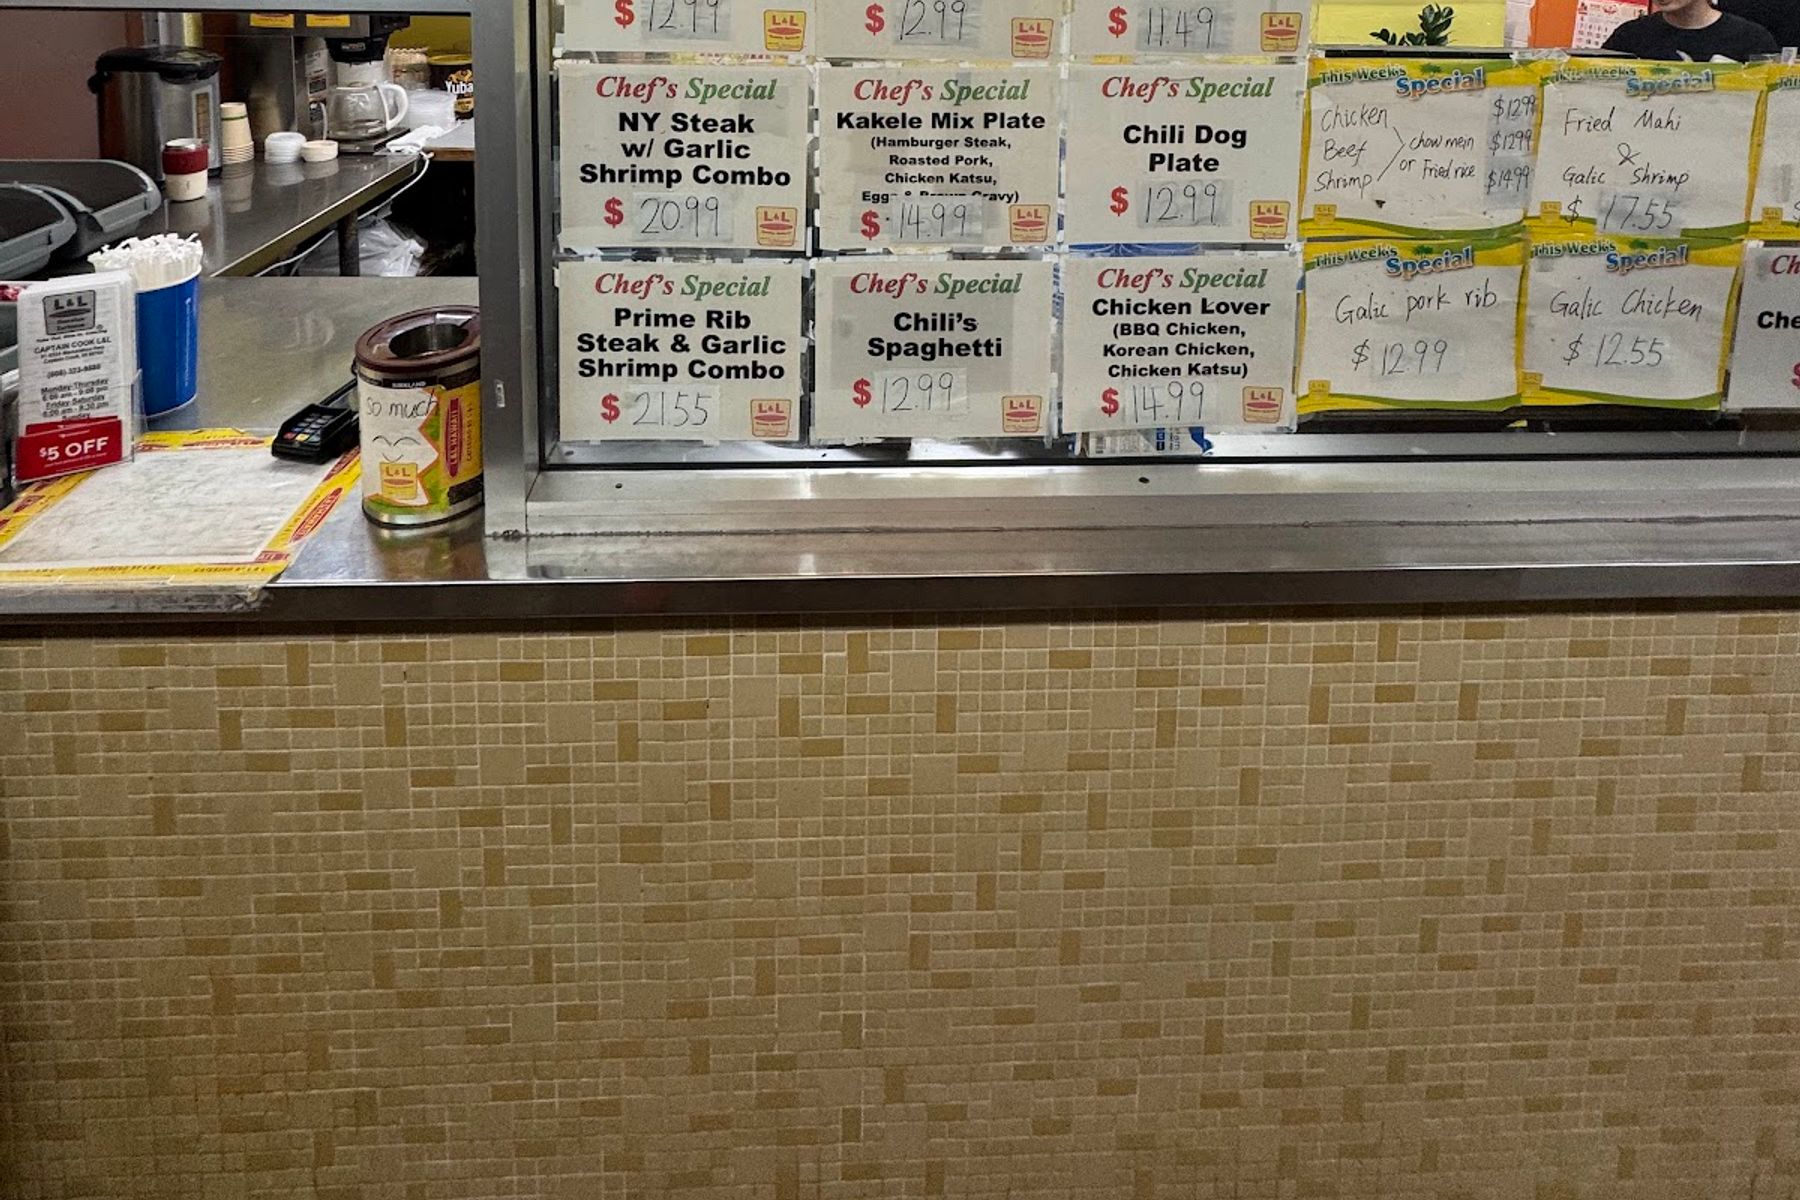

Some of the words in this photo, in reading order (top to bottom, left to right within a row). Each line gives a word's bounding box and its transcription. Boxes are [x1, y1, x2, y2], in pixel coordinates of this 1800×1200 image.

[865, 3, 884, 36] $
[900, 0, 966, 40] 12.99
[1108, 6, 1127, 38] $
[596, 76, 678, 104] Chef's
[684, 78, 778, 104] Special
[854, 79, 933, 106] Chef's
[940, 79, 1031, 106] Special
[1101, 77, 1180, 103] Chef's
[1185, 77, 1275, 103] Special
[1396, 67, 1484, 100] Special
[619, 113, 661, 132] NY
[671, 113, 755, 133] Steak
[837, 113, 923, 129] Kakele
[931, 113, 974, 129] Mix
[983, 113, 1045, 129] Plate
[1322, 105, 1388, 131] Chicken
[1564, 107, 1616, 135] Fried
[1633, 107, 1681, 131] Mahi
[621, 138, 654, 158] w/
[664, 138, 751, 159] Garlic
[871, 137, 959, 150] (Hamburger
[964, 137, 1011, 149] Steak,
[1124, 125, 1184, 144] Chili
[1195, 126, 1247, 148] Dog
[889, 155, 949, 166] Roasted
[955, 155, 993, 168] Pork,
[1149, 153, 1220, 172] Plate
[1324, 138, 1368, 167] Beef
[1400, 159, 1417, 172] or
[1618, 142, 1641, 166] &
[580, 164, 683, 188] Shrimp
[693, 165, 791, 187] Combo
[885, 173, 944, 183] Chicken
[949, 173, 997, 185] Katsu,
[1314, 171, 1373, 199] Shrimp
[1562, 166, 1606, 187] Galic
[1630, 163, 1690, 191] Shrimp
[862, 191, 897, 203] Egg
[1110, 186, 1129, 217] $
[1145, 183, 1222, 226] 12.99
[604, 197, 624, 228] $
[640, 196, 719, 238] 20.99
[861, 210, 880, 241] $
[900, 203, 968, 239] 14.99
[1567, 195, 1583, 226] $
[1385, 246, 1472, 280] Special
[1606, 244, 1688, 276] Special
[595, 273, 675, 300] Chef's
[680, 275, 771, 301] Special
[850, 272, 928, 299] Chef's
[933, 273, 1023, 300] Special
[1097, 268, 1173, 293] Chef's
[1179, 268, 1268, 293] Special
[1092, 299, 1191, 316] Chicken
[1201, 298, 1271, 315] Lover
[1335, 293, 1389, 325] Galic
[1406, 285, 1451, 322] pork
[1465, 278, 1497, 308] rib
[1550, 287, 1603, 320] Galic
[1622, 287, 1702, 322] Chicken
[614, 308, 696, 328] Prime
[706, 310, 751, 329] Rib
[894, 312, 978, 331] Chili's
[1113, 324, 1160, 339] (BBQ
[1166, 323, 1247, 338] Chicken,
[577, 333, 660, 353] Steak
[670, 334, 690, 353] &
[701, 335, 786, 355] Garlic
[867, 338, 1002, 362] Spaghetti
[1103, 344, 1169, 357] Korean
[1175, 343, 1255, 358] Chicken,
[1352, 339, 1369, 371] $
[1563, 333, 1583, 366] $
[578, 359, 678, 382] Shrimp
[688, 359, 785, 380] Combo
[1108, 364, 1181, 378] Chicken
[1187, 363, 1248, 379] Katsu)
[389, 388, 439, 419] much
[853, 378, 872, 408] $
[881, 372, 954, 414] 12.99
[1101, 387, 1119, 417] $
[1132, 381, 1205, 423] 14.99
[600, 393, 620, 424] $
[39, 443, 60, 461] $5
[65, 436, 109, 457] OFF
